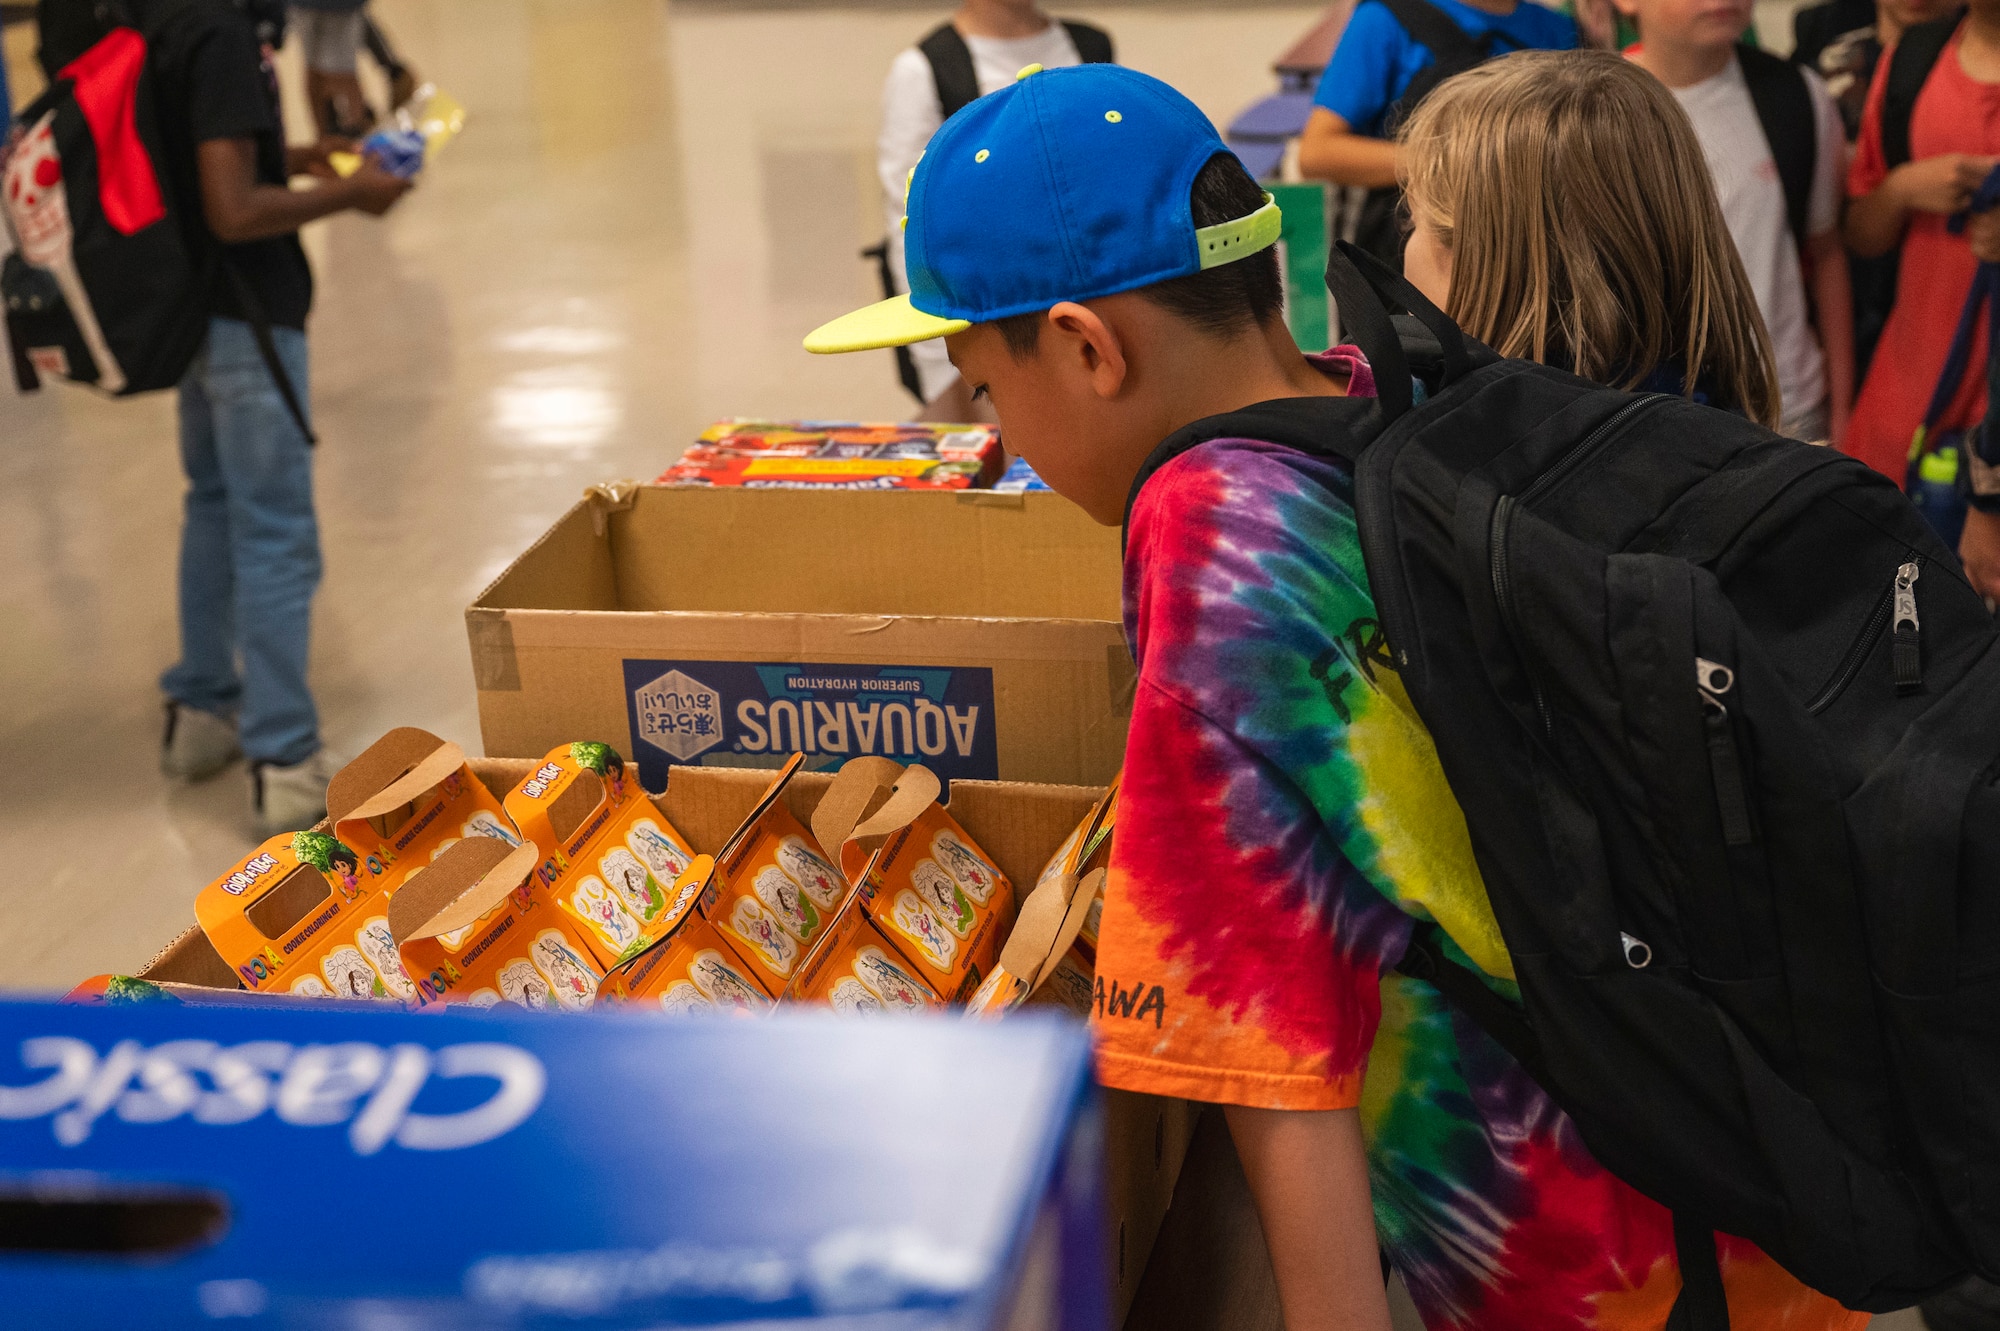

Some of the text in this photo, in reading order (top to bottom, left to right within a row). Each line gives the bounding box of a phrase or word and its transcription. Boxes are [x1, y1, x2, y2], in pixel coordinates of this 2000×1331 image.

[1898, 597, 1912, 615] JS
[644, 692, 712, 711] おいしい!
[788, 677, 920, 692] SUPERIOR HYDRATION
[736, 699, 979, 757] AQUARIUS
[395, 801, 446, 851] COOKIE COLORING KIT
[568, 807, 611, 858] COOKIE COLORING KIT
[366, 843, 398, 879] ORA
[283, 903, 341, 955] COOKIE COLORING KIT
[461, 914, 515, 968] COOKIE COLORING KIT
[239, 945, 284, 989] DORA
[419, 958, 462, 1002] DORA
[629, 970, 647, 991] COOKIE
[644, 946, 667, 972] COLORING
[0, 1036, 547, 1155] Classic
